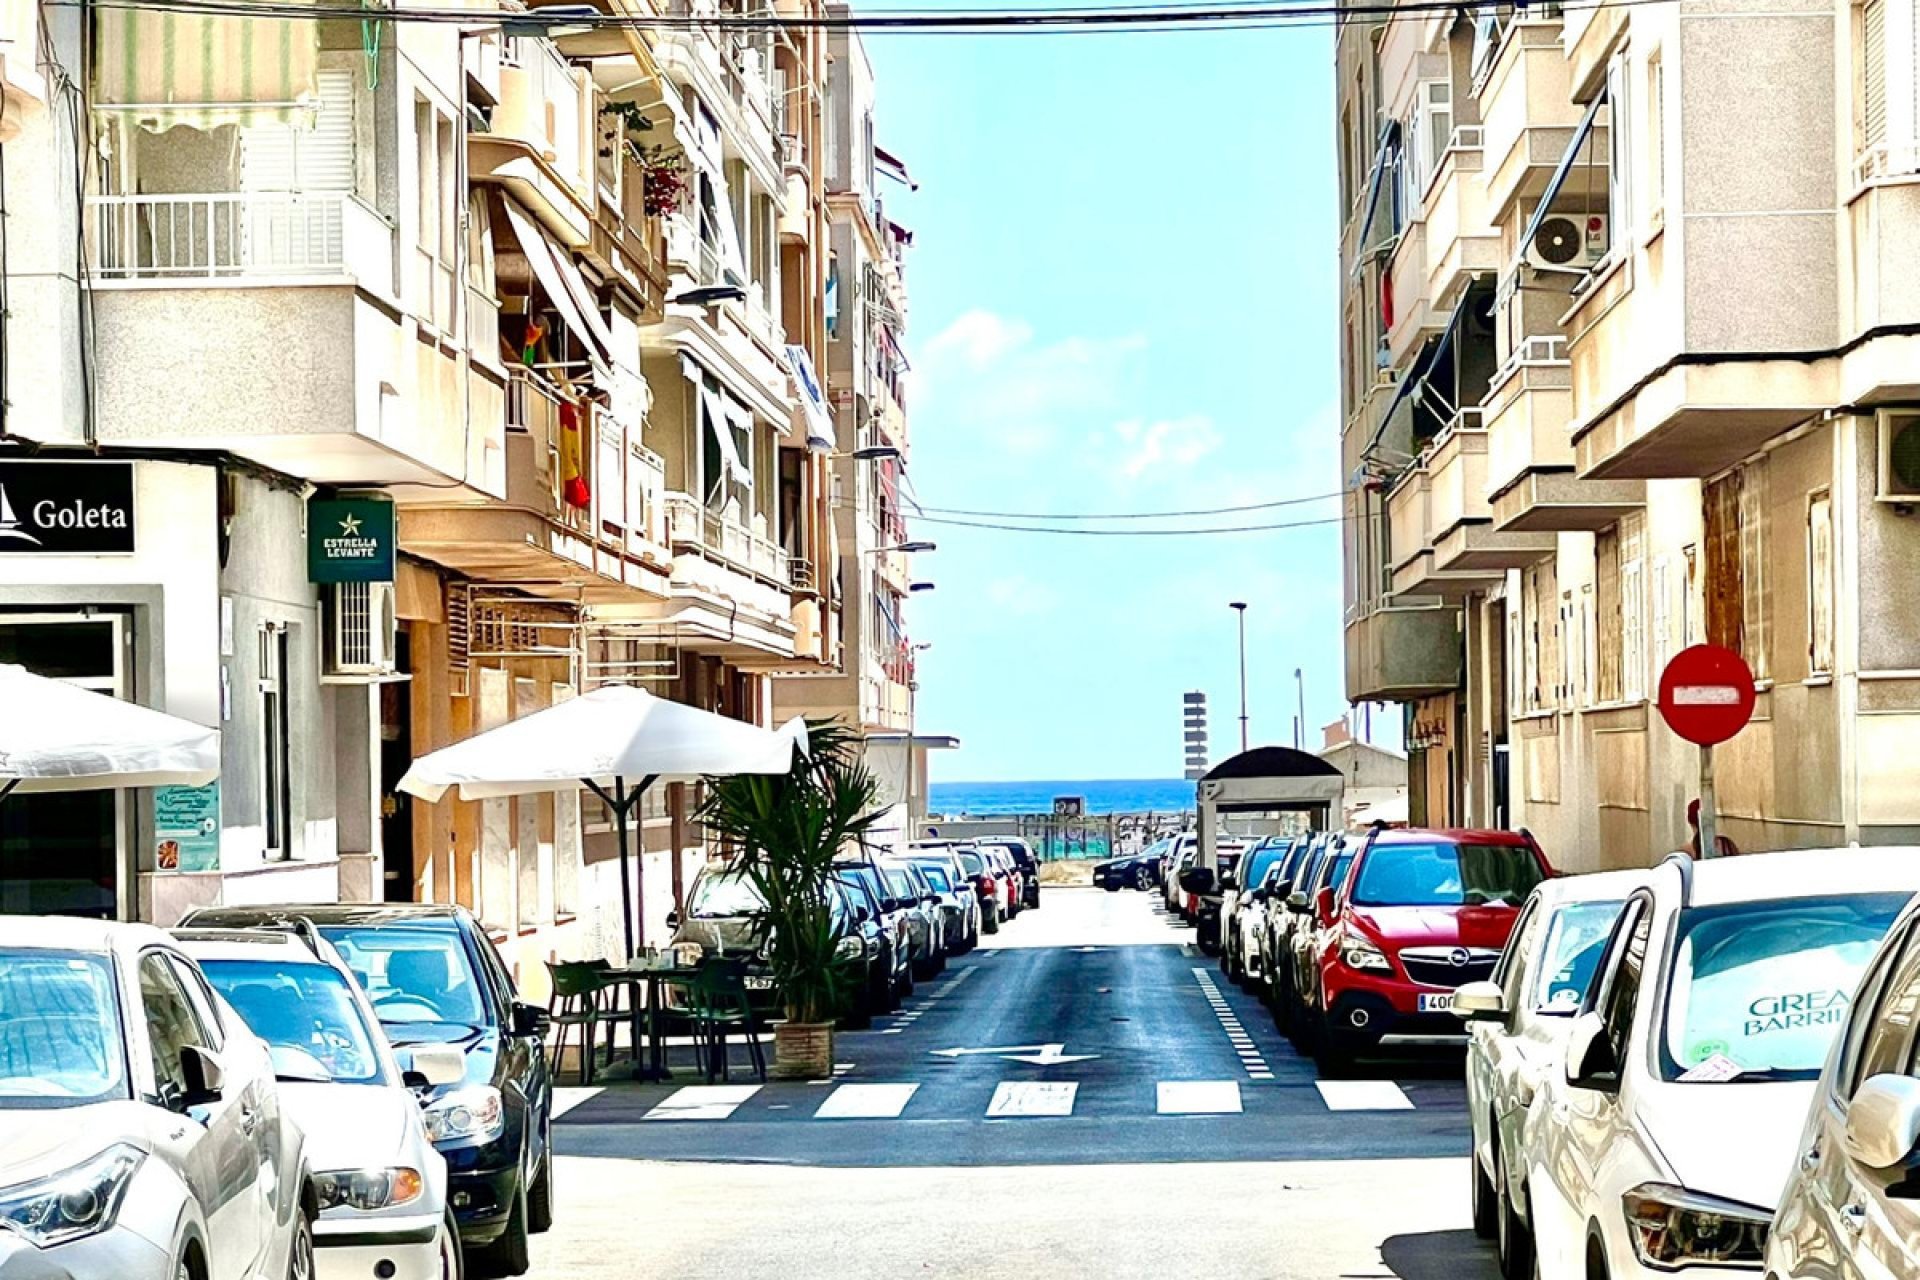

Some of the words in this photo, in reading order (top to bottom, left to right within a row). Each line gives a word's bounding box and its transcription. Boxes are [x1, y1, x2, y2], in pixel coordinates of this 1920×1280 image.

[33, 499, 127, 529] Goleta
[323, 538, 377, 548] ESTRELLA
[327, 548, 375, 558] LEVANTE
[1749, 988, 1850, 1017] GREA
